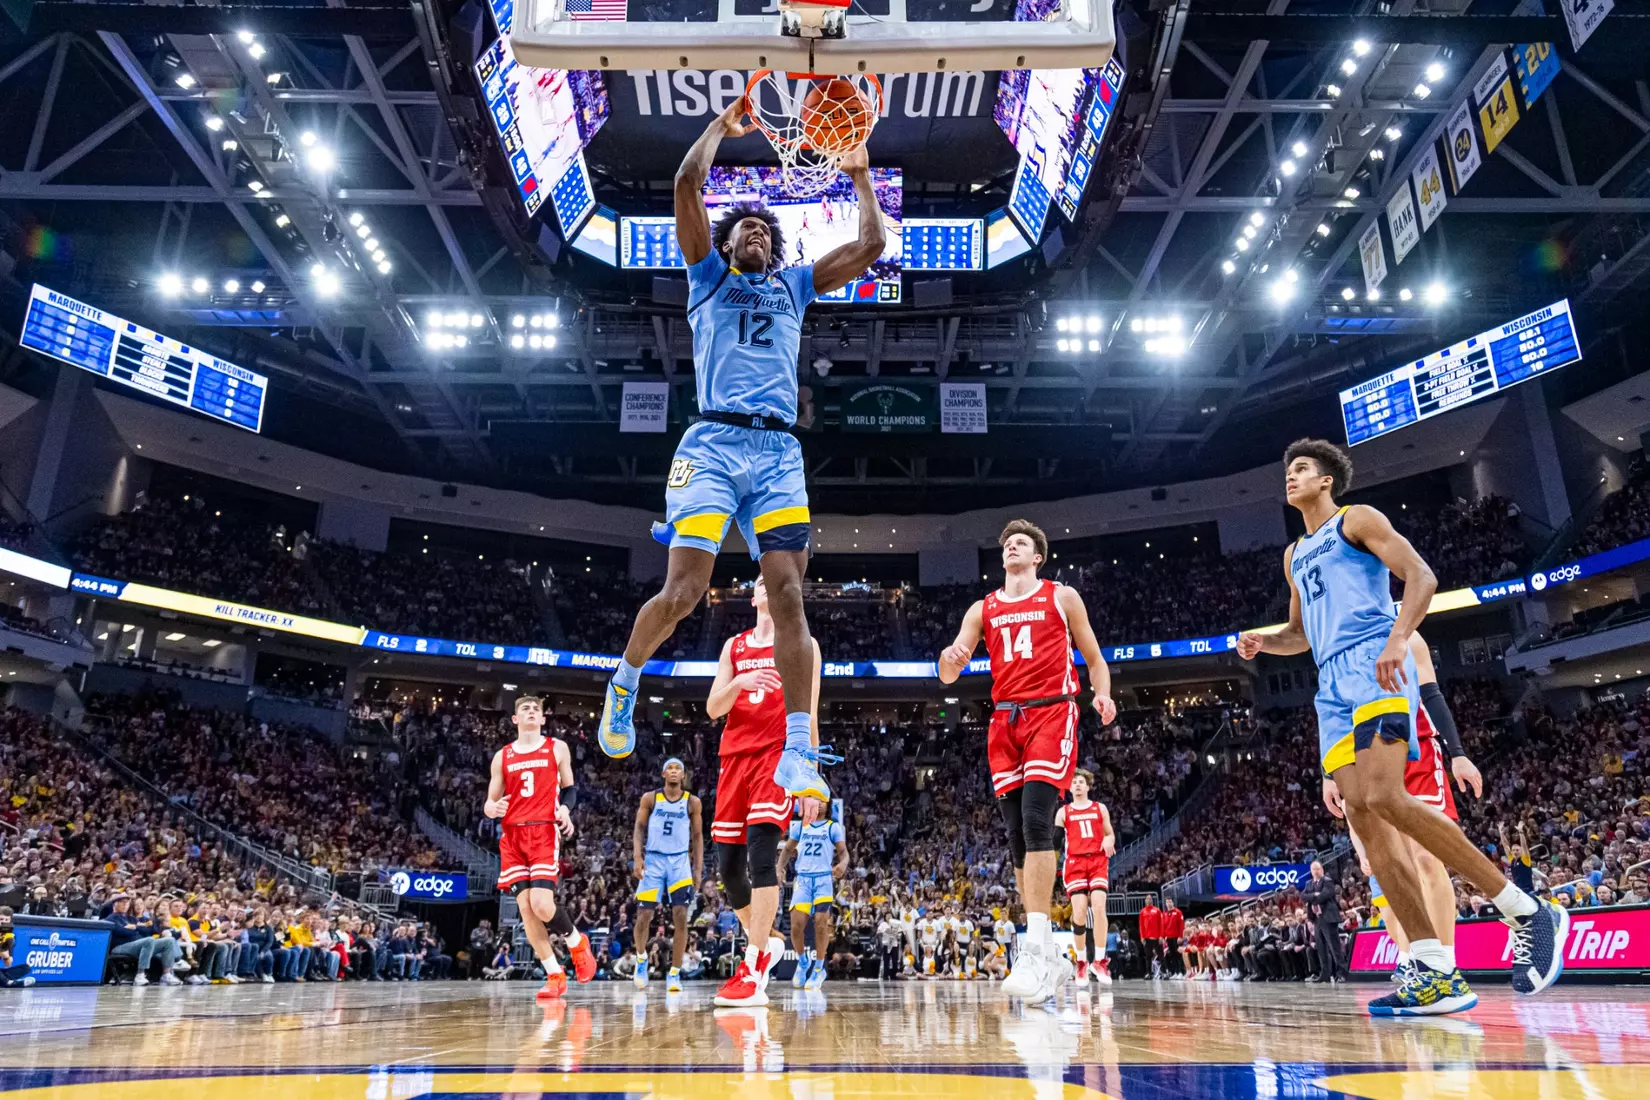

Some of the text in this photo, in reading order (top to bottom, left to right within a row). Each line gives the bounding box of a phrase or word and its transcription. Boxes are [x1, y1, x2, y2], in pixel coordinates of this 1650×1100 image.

[1486, 87, 1509, 129] 14
[1456, 130, 1471, 161] 24
[1421, 166, 1440, 206] 44
[1392, 204, 1413, 239] HANK
[48, 291, 102, 322] MARQUETTE
[721, 287, 792, 312] Marquette
[738, 309, 775, 348] 12
[1502, 307, 1553, 335] WISCONSIN
[212, 359, 255, 382] WISCONSIN
[950, 390, 977, 398] DIVISION
[1351, 373, 1394, 397] MARQUETTE
[625, 393, 666, 402] CONFERENCE
[626, 402, 664, 410] CHAMPIONS
[944, 399, 983, 407] CHAMPIONS
[847, 416, 926, 425] WORLD CHAMPIONS
[1549, 565, 1582, 581] edge
[1301, 564, 1327, 606] 13
[1482, 583, 1526, 599] 4:44 PM
[215, 604, 294, 627] KILL TRACKER: XX
[990, 611, 1046, 629] WISCONSIN
[377, 635, 399, 648] FLS
[415, 639, 427, 652] 2
[455, 643, 477, 656] TOL
[1001, 625, 1034, 663] 14
[1190, 641, 1212, 652] TOL
[1226, 636, 1237, 648] 3
[493, 646, 504, 659] 3
[1114, 647, 1135, 659] FLS
[736, 658, 776, 671] WISCONS
[824, 662, 854, 675] 2nd
[520, 770, 535, 798] 3
[662, 820, 674, 836] 5
[1079, 820, 1095, 839] 11
[804, 843, 823, 856] 22
[413, 875, 454, 897] edge
[1256, 867, 1298, 889] edge
[26, 950, 73, 968] GRUBER
